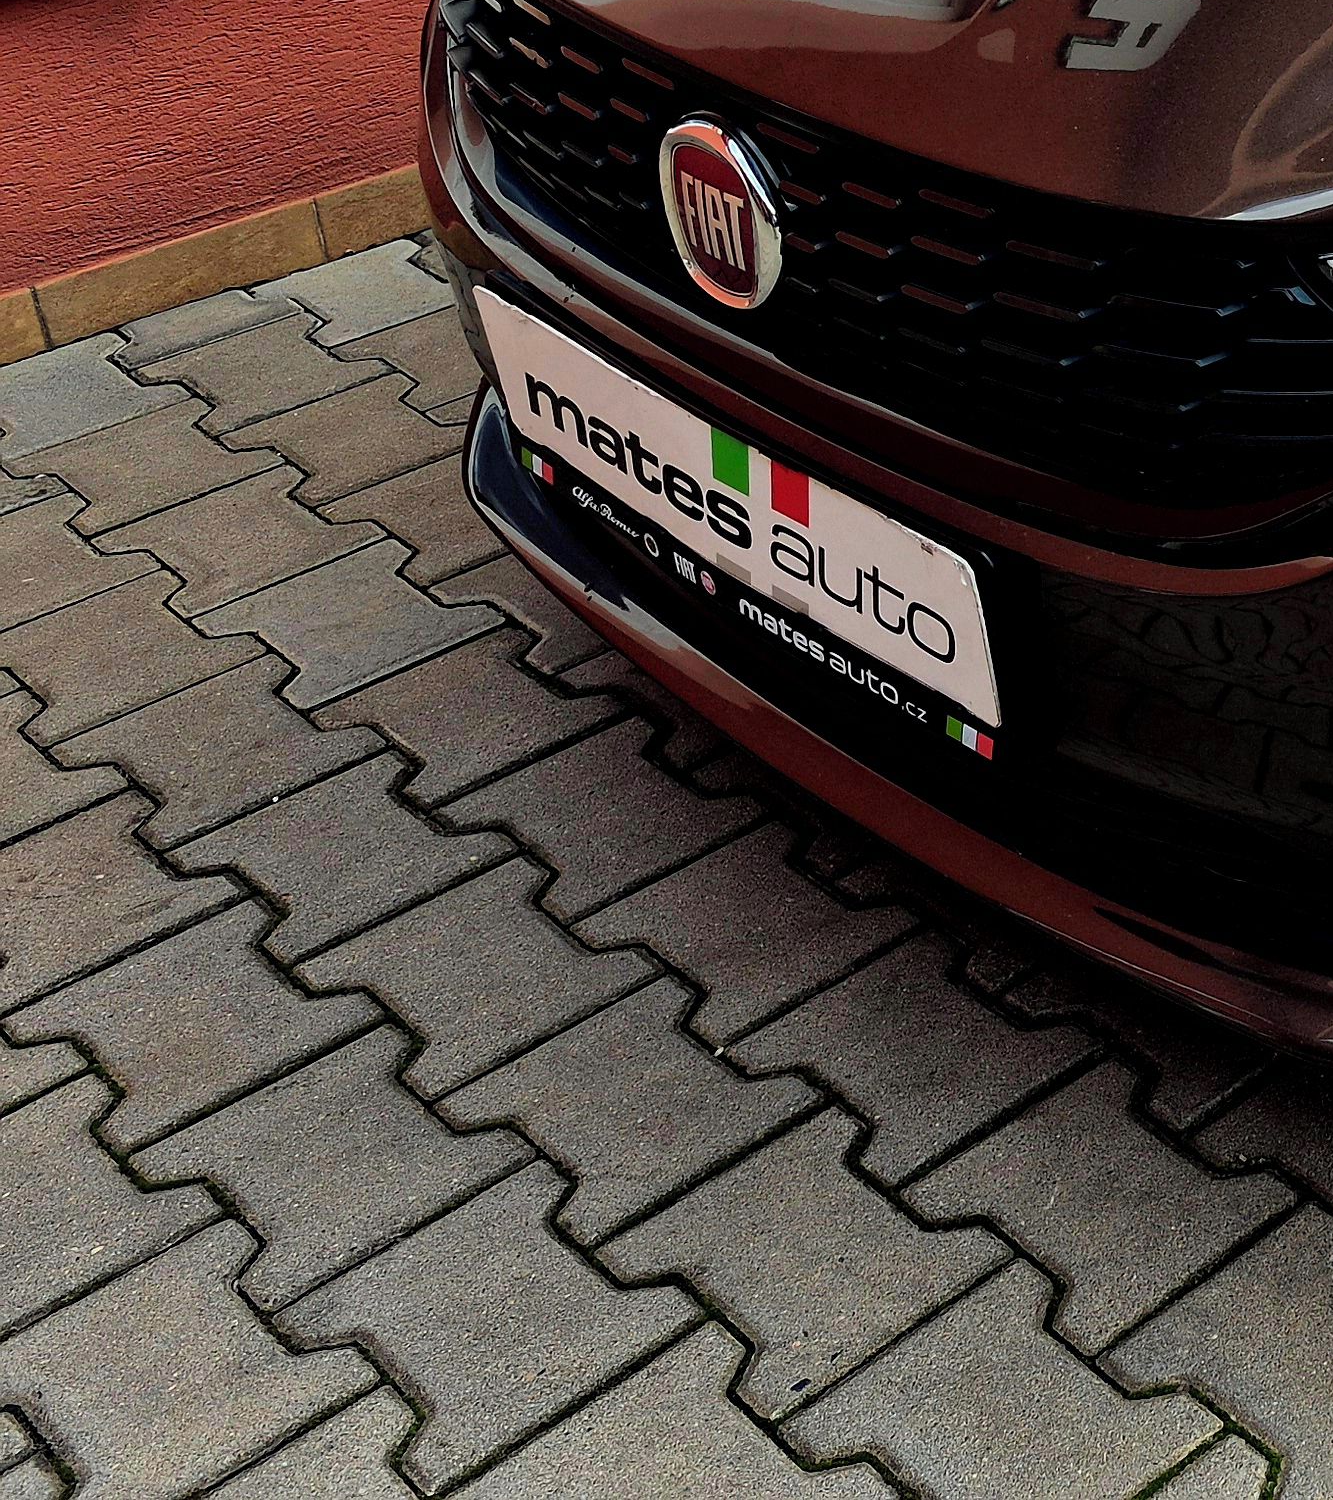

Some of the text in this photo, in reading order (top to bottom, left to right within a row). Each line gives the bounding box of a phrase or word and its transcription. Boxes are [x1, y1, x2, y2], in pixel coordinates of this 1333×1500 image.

[680, 170, 746, 272] FIAT
[525, 372, 956, 664] mates auto
[673, 552, 697, 584] FIAT
[739, 598, 928, 724] mates auto.cz
